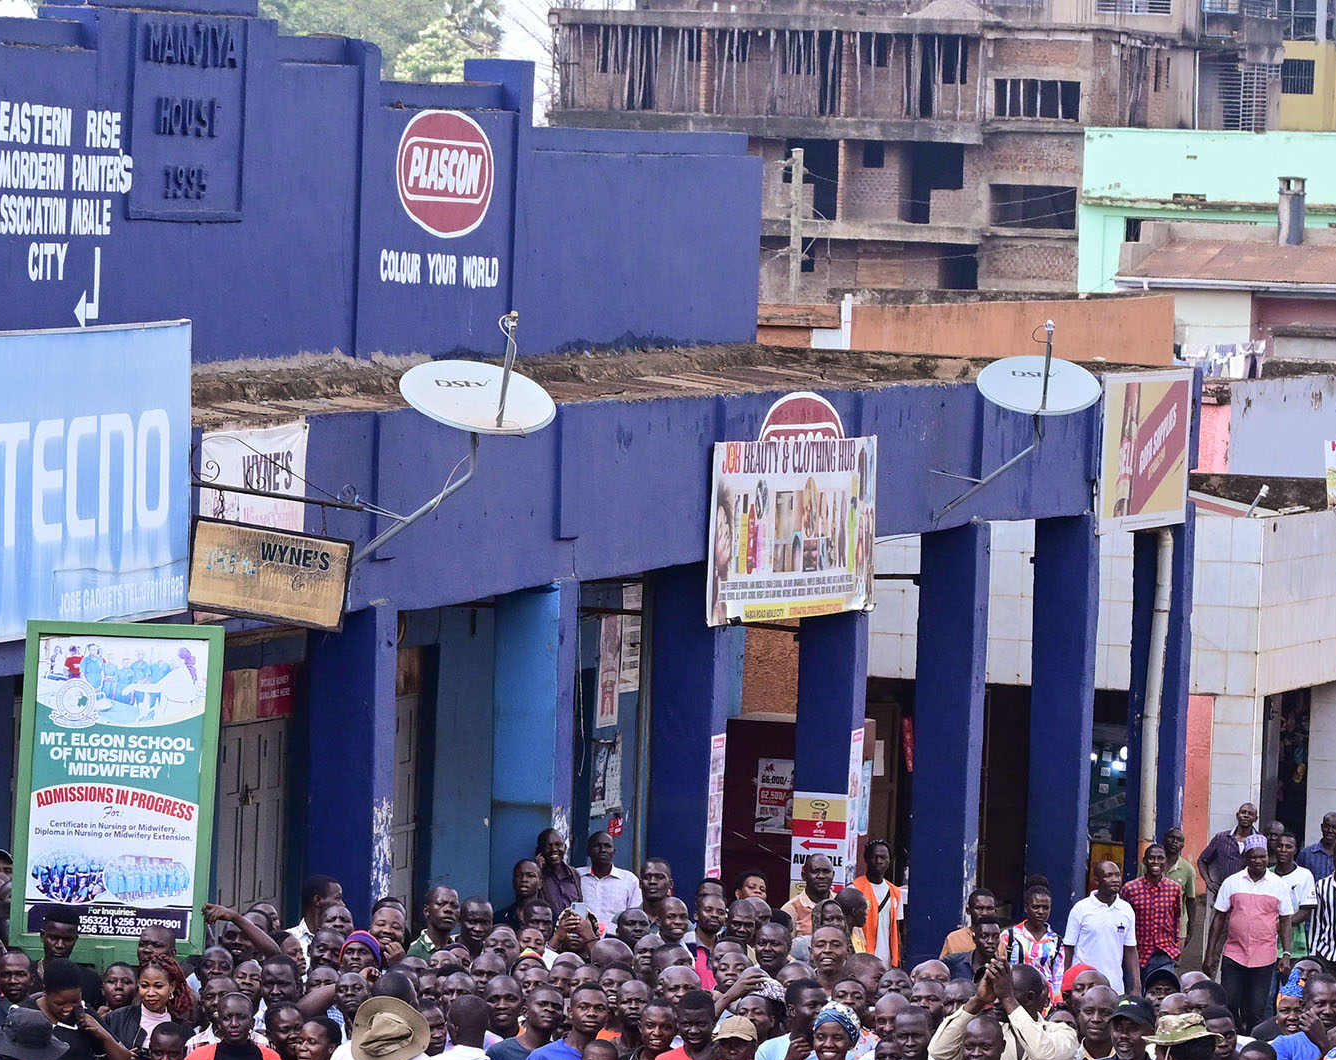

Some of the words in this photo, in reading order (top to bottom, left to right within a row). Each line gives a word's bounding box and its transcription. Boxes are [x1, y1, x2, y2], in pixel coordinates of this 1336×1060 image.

[0, 101, 72, 146] EASTERN
[86, 110, 121, 149] RISE
[408, 146, 483, 196] PLASCON
[71, 198, 111, 236] MBALE
[28, 242, 69, 281] CITY
[380, 248, 421, 285] COLOUR
[428, 251, 456, 285] YOUR
[463, 255, 499, 289] WORLD
[242, 451, 293, 492] WYNE'S
[743, 441, 780, 474] BEAUTY
[783, 442, 789, 473] &
[792, 441, 836, 473] CLOTHING
[839, 439, 856, 472] HUB
[261, 542, 330, 571] WYNE'S
[59, 591, 81, 615] JOSE
[84, 584, 122, 609] GADGETS
[40, 732, 67, 746] MT.
[71, 733, 125, 748] ELGON
[128, 736, 195, 751] SCHOOL
[50, 747, 72, 760] OF
[75, 747, 147, 764] NURSING
[150, 751, 185, 765] AND
[68, 762, 162, 779] MIDWIFERY
[37, 786, 113, 808] ADMISSIONS
[116, 789, 129, 805] IN
[131, 792, 194, 821] PROGRESS
[103, 806, 124, 819] For:
[35, 828, 65, 837] Diploma
[74, 830, 103, 839] Nursing
[114, 831, 151, 840] Midwifery
[50, 820, 88, 828] Certificate
[98, 823, 127, 831] Nursing
[138, 824, 178, 833] Midwifery.
[101, 907, 136, 916] Inquiries:
[99, 926, 114, 934] 782
